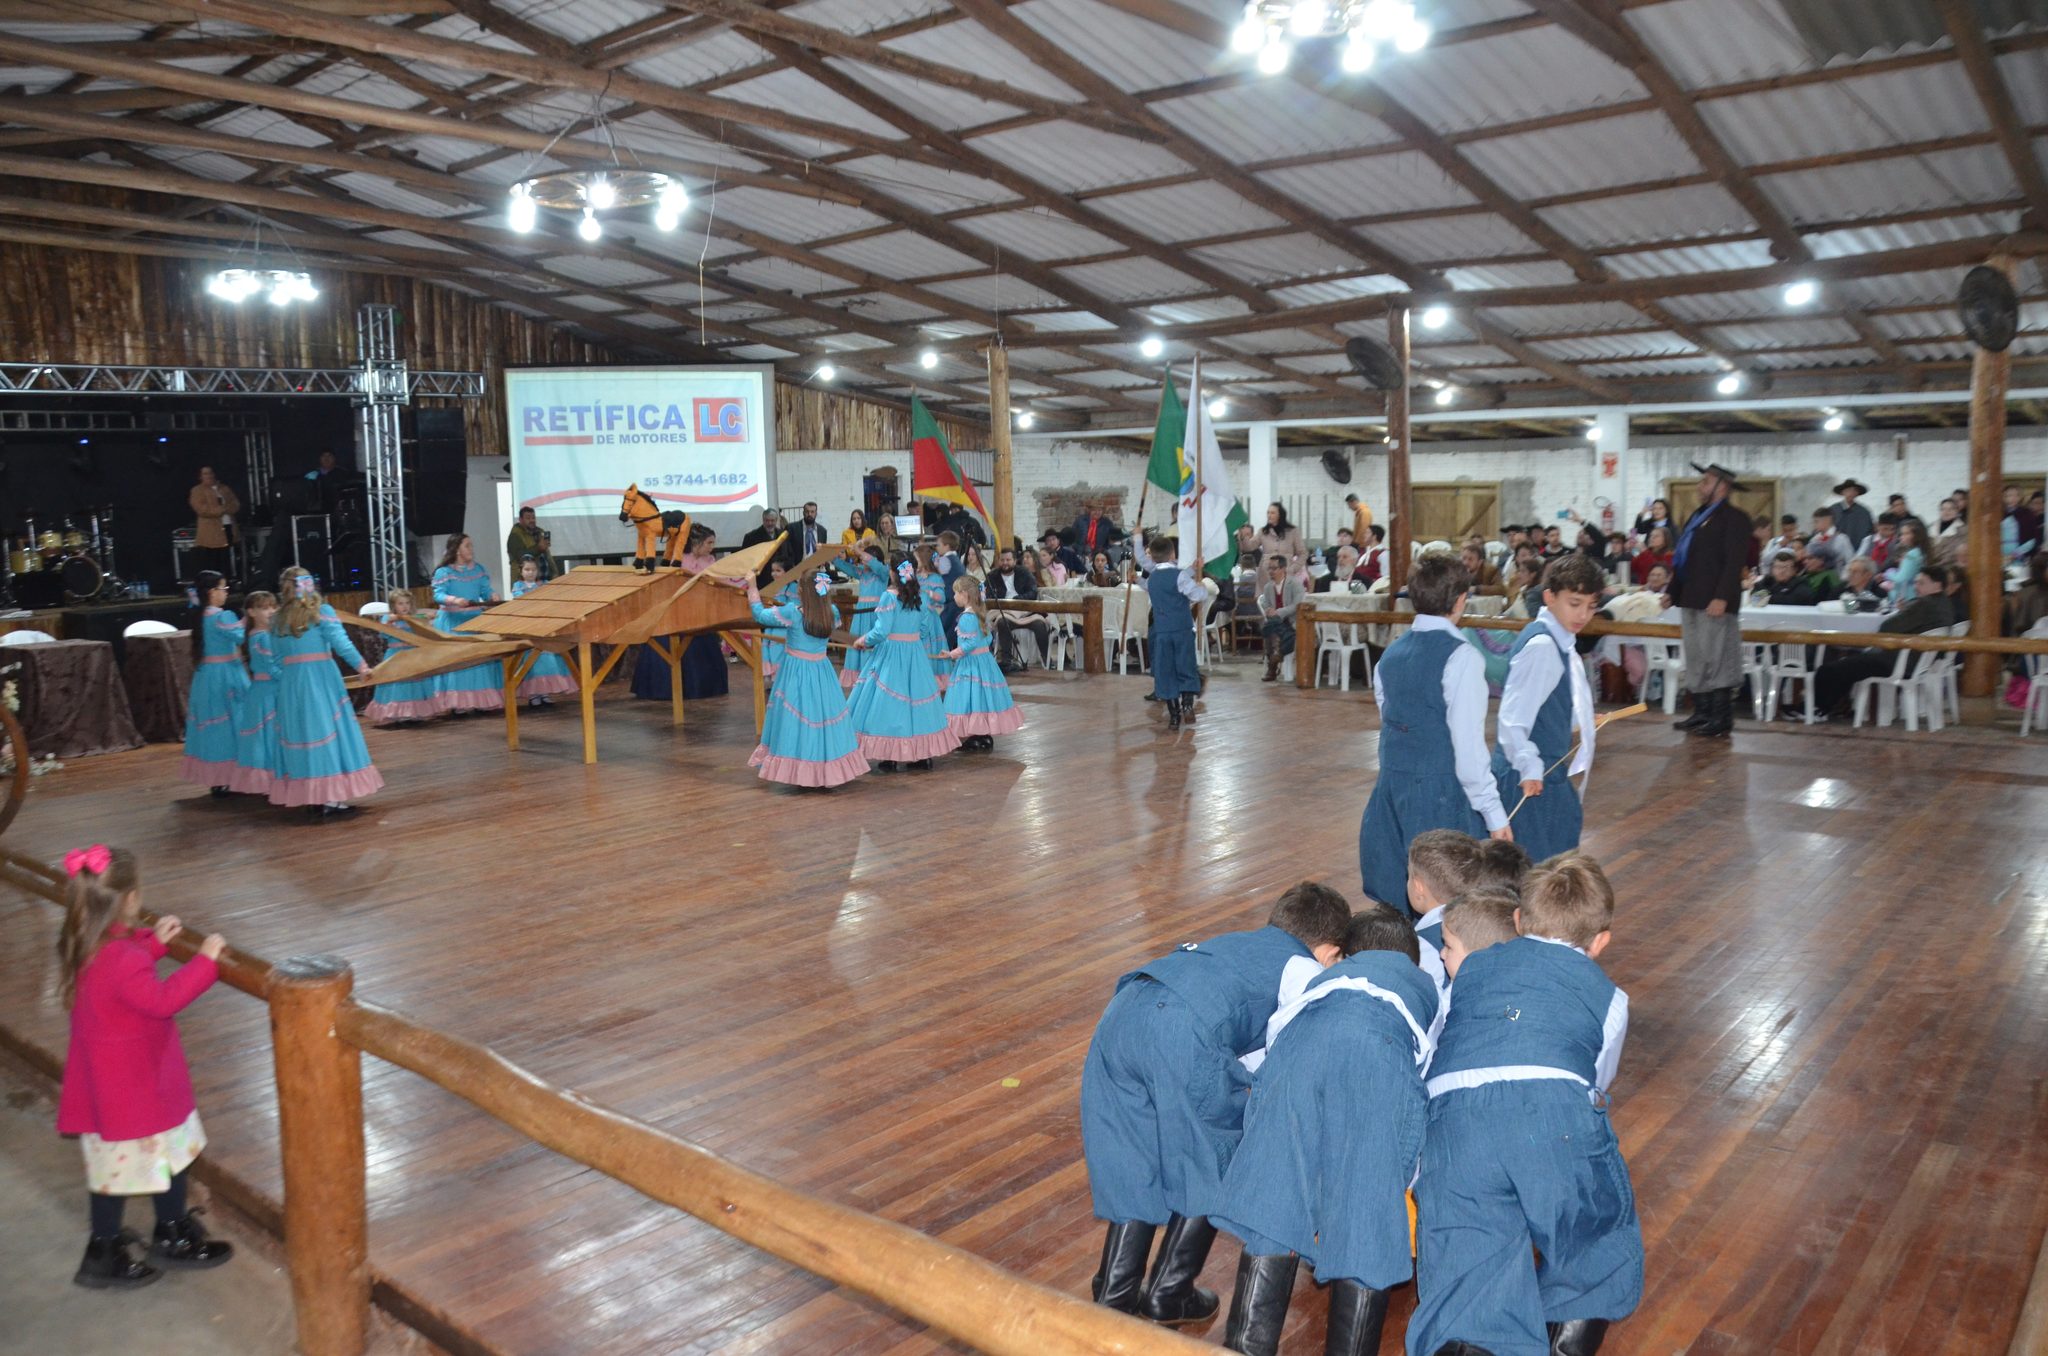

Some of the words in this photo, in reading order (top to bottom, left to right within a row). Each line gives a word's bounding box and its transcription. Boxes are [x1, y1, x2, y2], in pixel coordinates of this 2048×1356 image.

[523, 399, 686, 432] RETÍFICA
[700, 403, 743, 436] LC
[596, 434, 615, 445] DE
[619, 433, 687, 444] MOTORES
[644, 477, 660, 487] 55
[664, 473, 748, 486] 3744-1682
